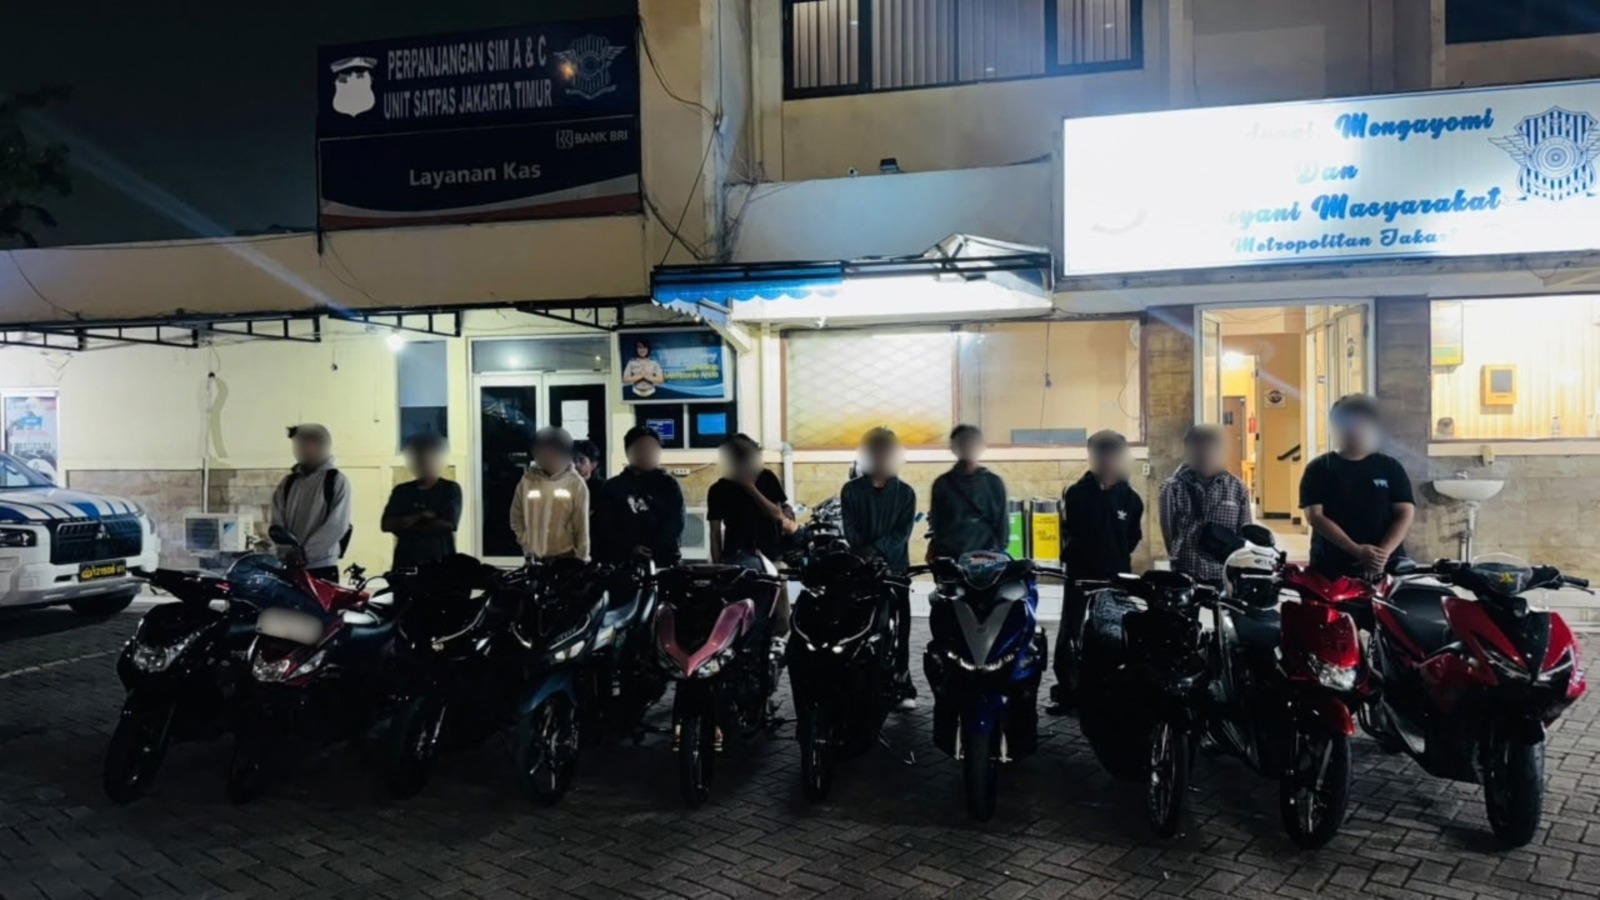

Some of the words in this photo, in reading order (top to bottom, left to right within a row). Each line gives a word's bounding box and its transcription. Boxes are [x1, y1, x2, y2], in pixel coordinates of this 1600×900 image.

[388, 43, 485, 80] PERPANJANGAN
[487, 40, 510, 72] SIM
[513, 39, 523, 69] A
[526, 37, 535, 67] &
[538, 35, 547, 66] C
[384, 91, 412, 120] UNIT
[413, 87, 456, 118] SATPAS
[459, 83, 511, 113] JAKARTA
[514, 79, 552, 109] TIMUR
[575, 131, 608, 144] BANK
[610, 130, 628, 142] BRI
[1335, 107, 1494, 141] Mengayomi
[409, 166, 496, 189] Layanan
[504, 162, 541, 180] Kas
[1311, 187, 1501, 222] Masyarakat
[1230, 233, 1372, 253] Metropolitan
